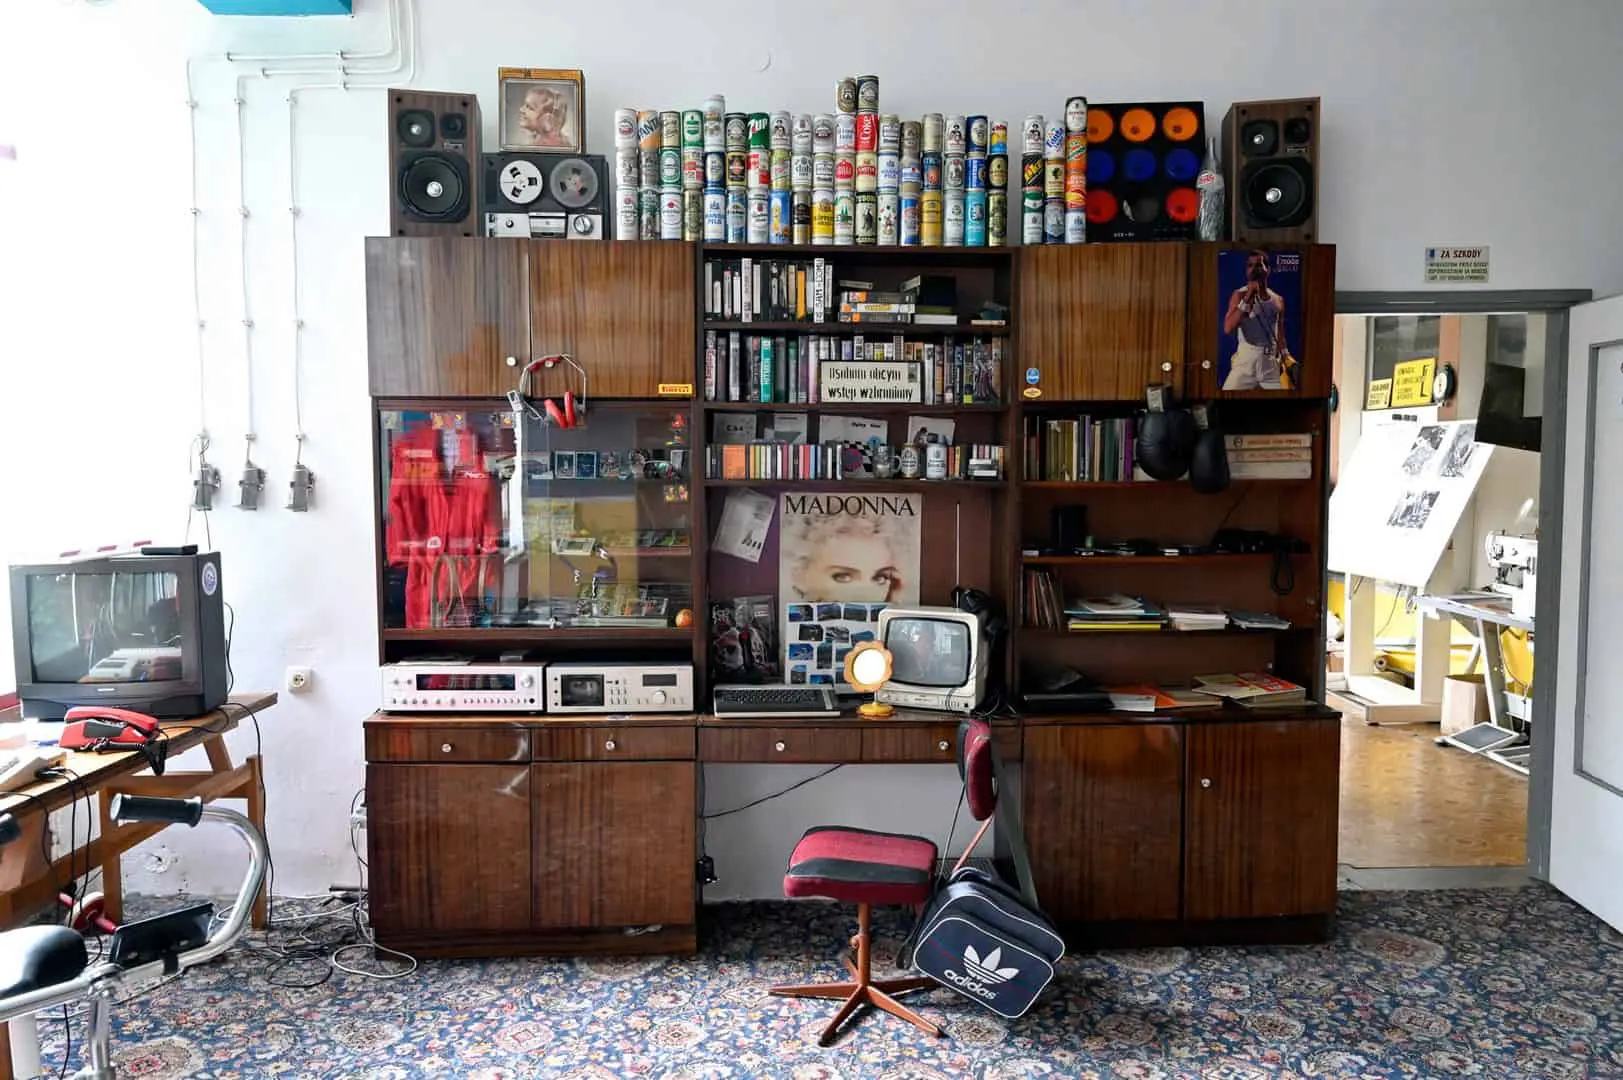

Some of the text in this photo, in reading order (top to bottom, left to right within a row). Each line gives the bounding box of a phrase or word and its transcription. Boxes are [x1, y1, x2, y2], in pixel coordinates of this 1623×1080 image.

[1440, 248, 1482, 258] ZA SZKODY
[869, 367, 901, 382] obcym
[828, 385, 913, 401] wstęp wzbroniony
[785, 495, 914, 516] MADONNA
[943, 969, 996, 1000] adidas
